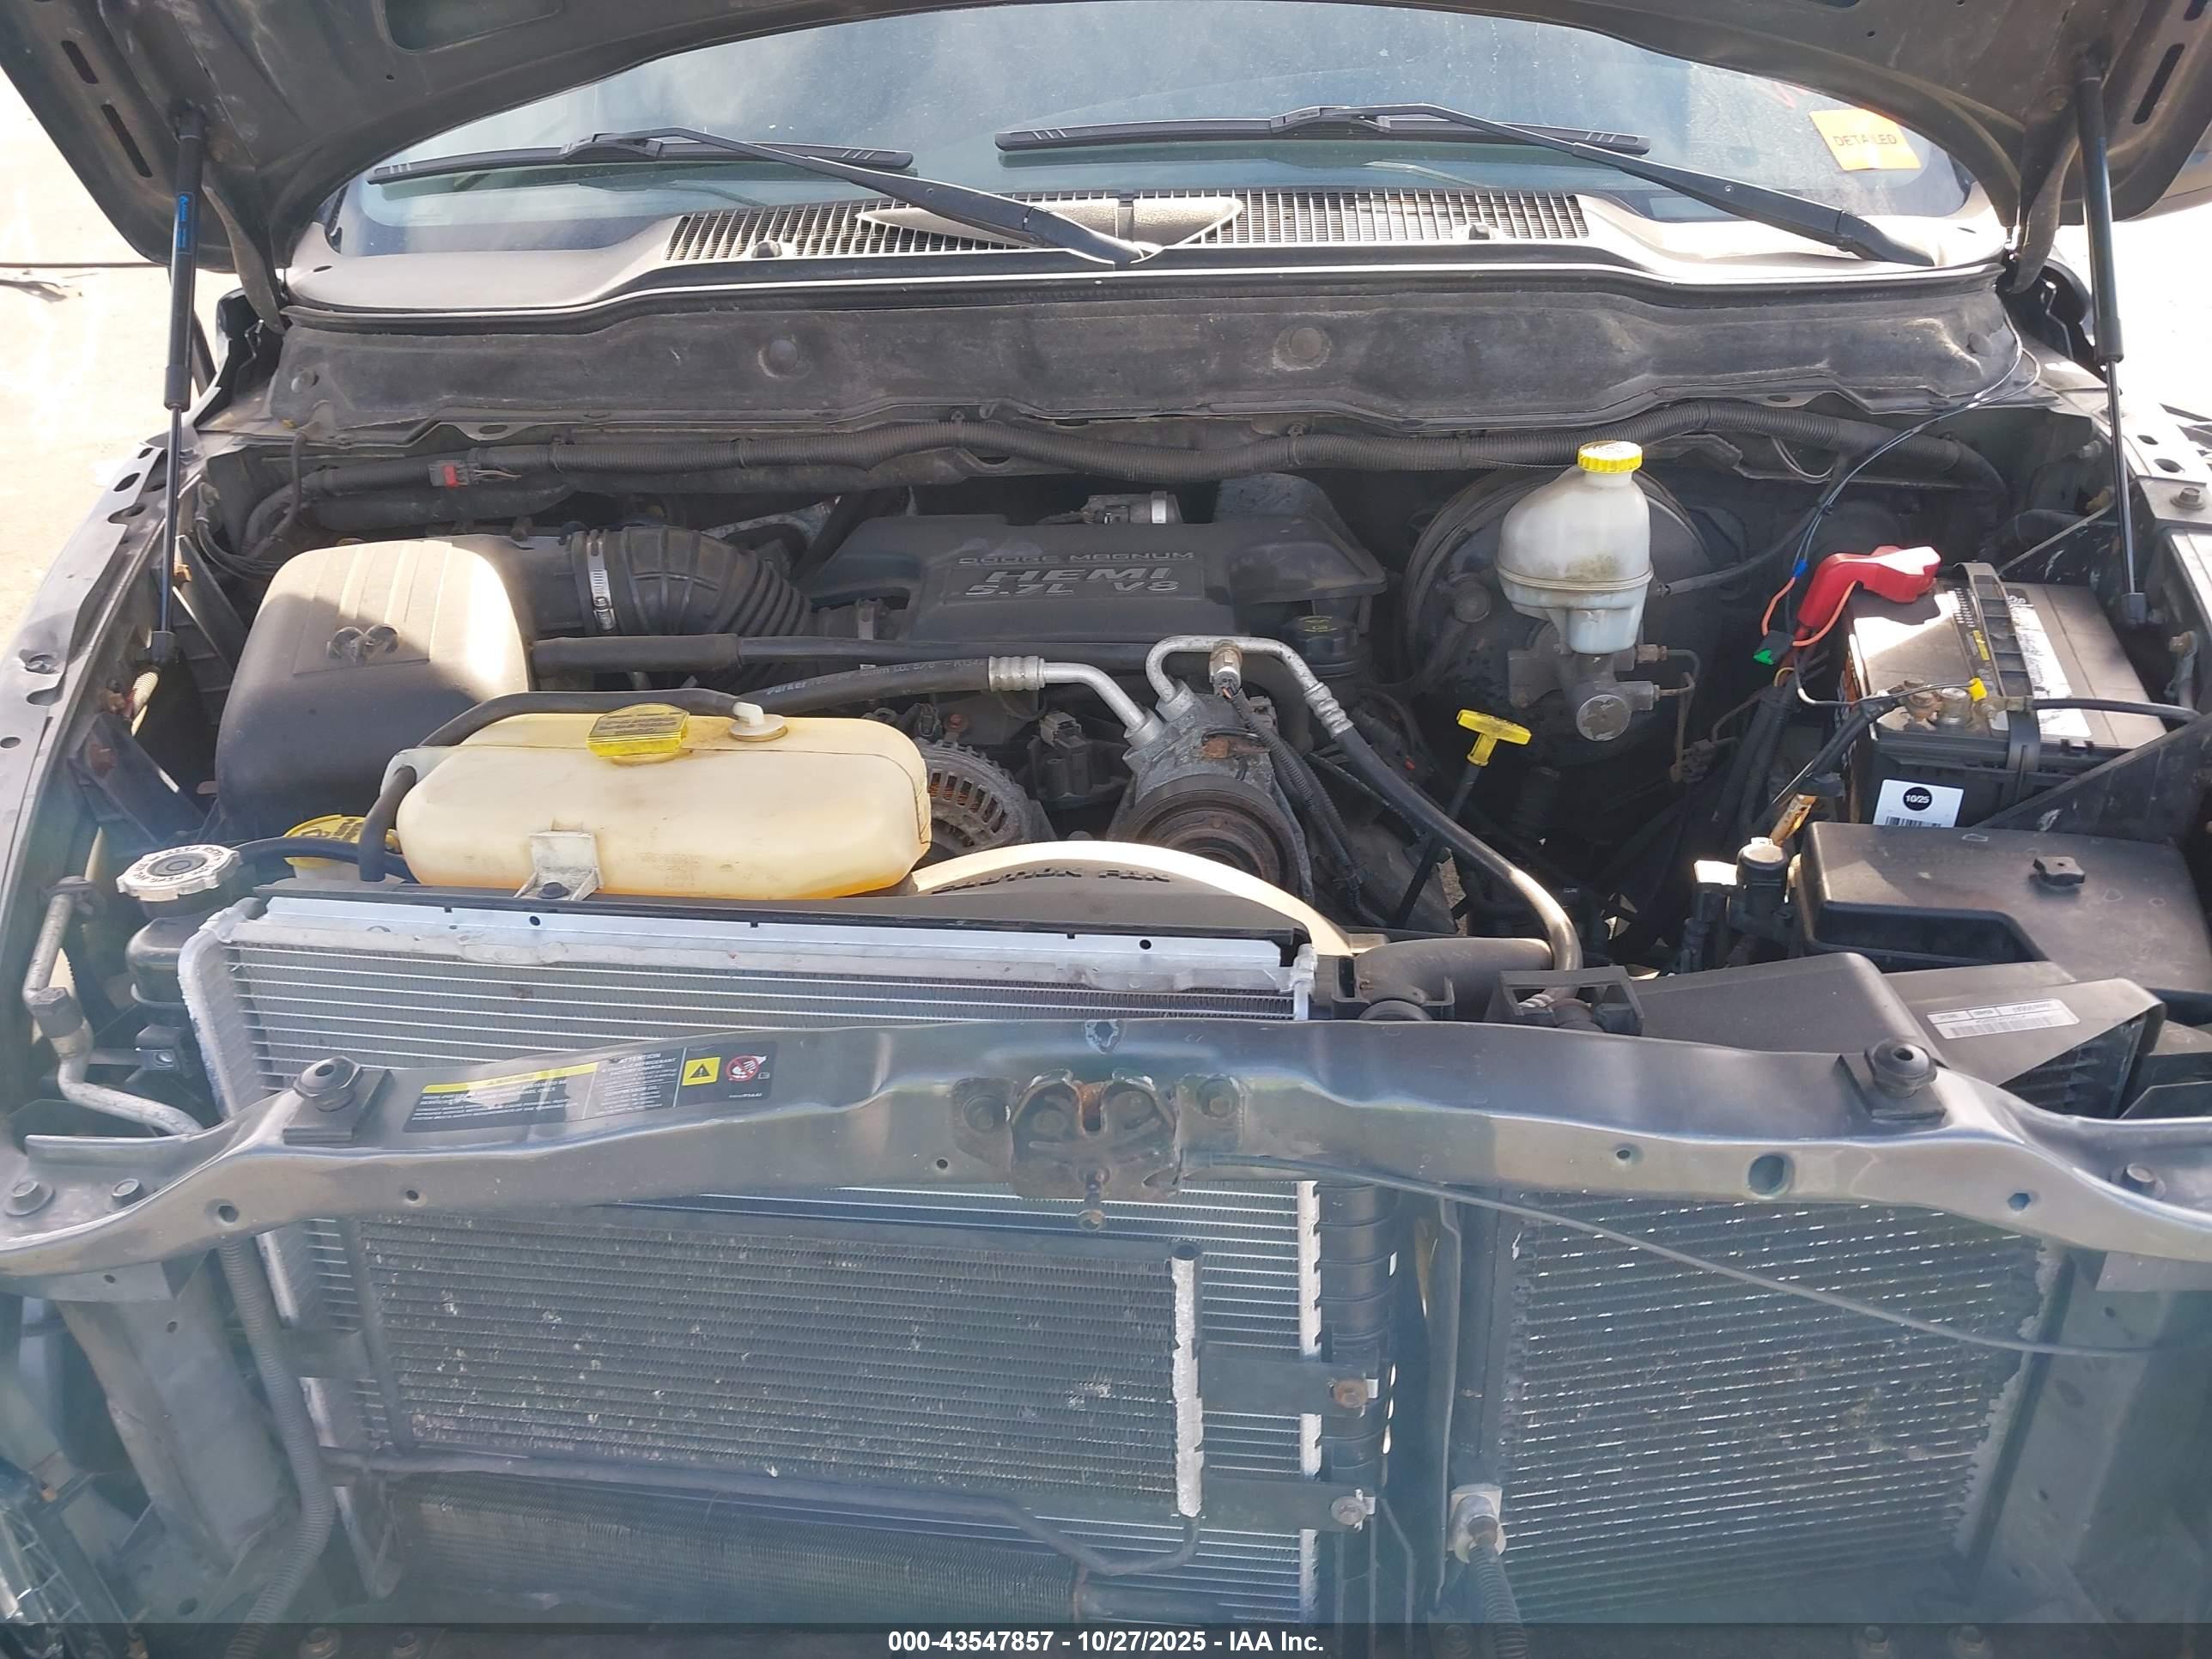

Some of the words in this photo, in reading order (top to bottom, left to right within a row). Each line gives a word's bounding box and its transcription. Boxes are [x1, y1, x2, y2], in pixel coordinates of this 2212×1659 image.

[1832, 133, 1898, 146] DETALED
[1070, 551, 1194, 561] MAGNUM
[986, 567, 1172, 583] HEMI
[965, 583, 1073, 596] 5.7L
[1113, 580, 1180, 592] V8
[1905, 794, 1930, 804] 10/25
